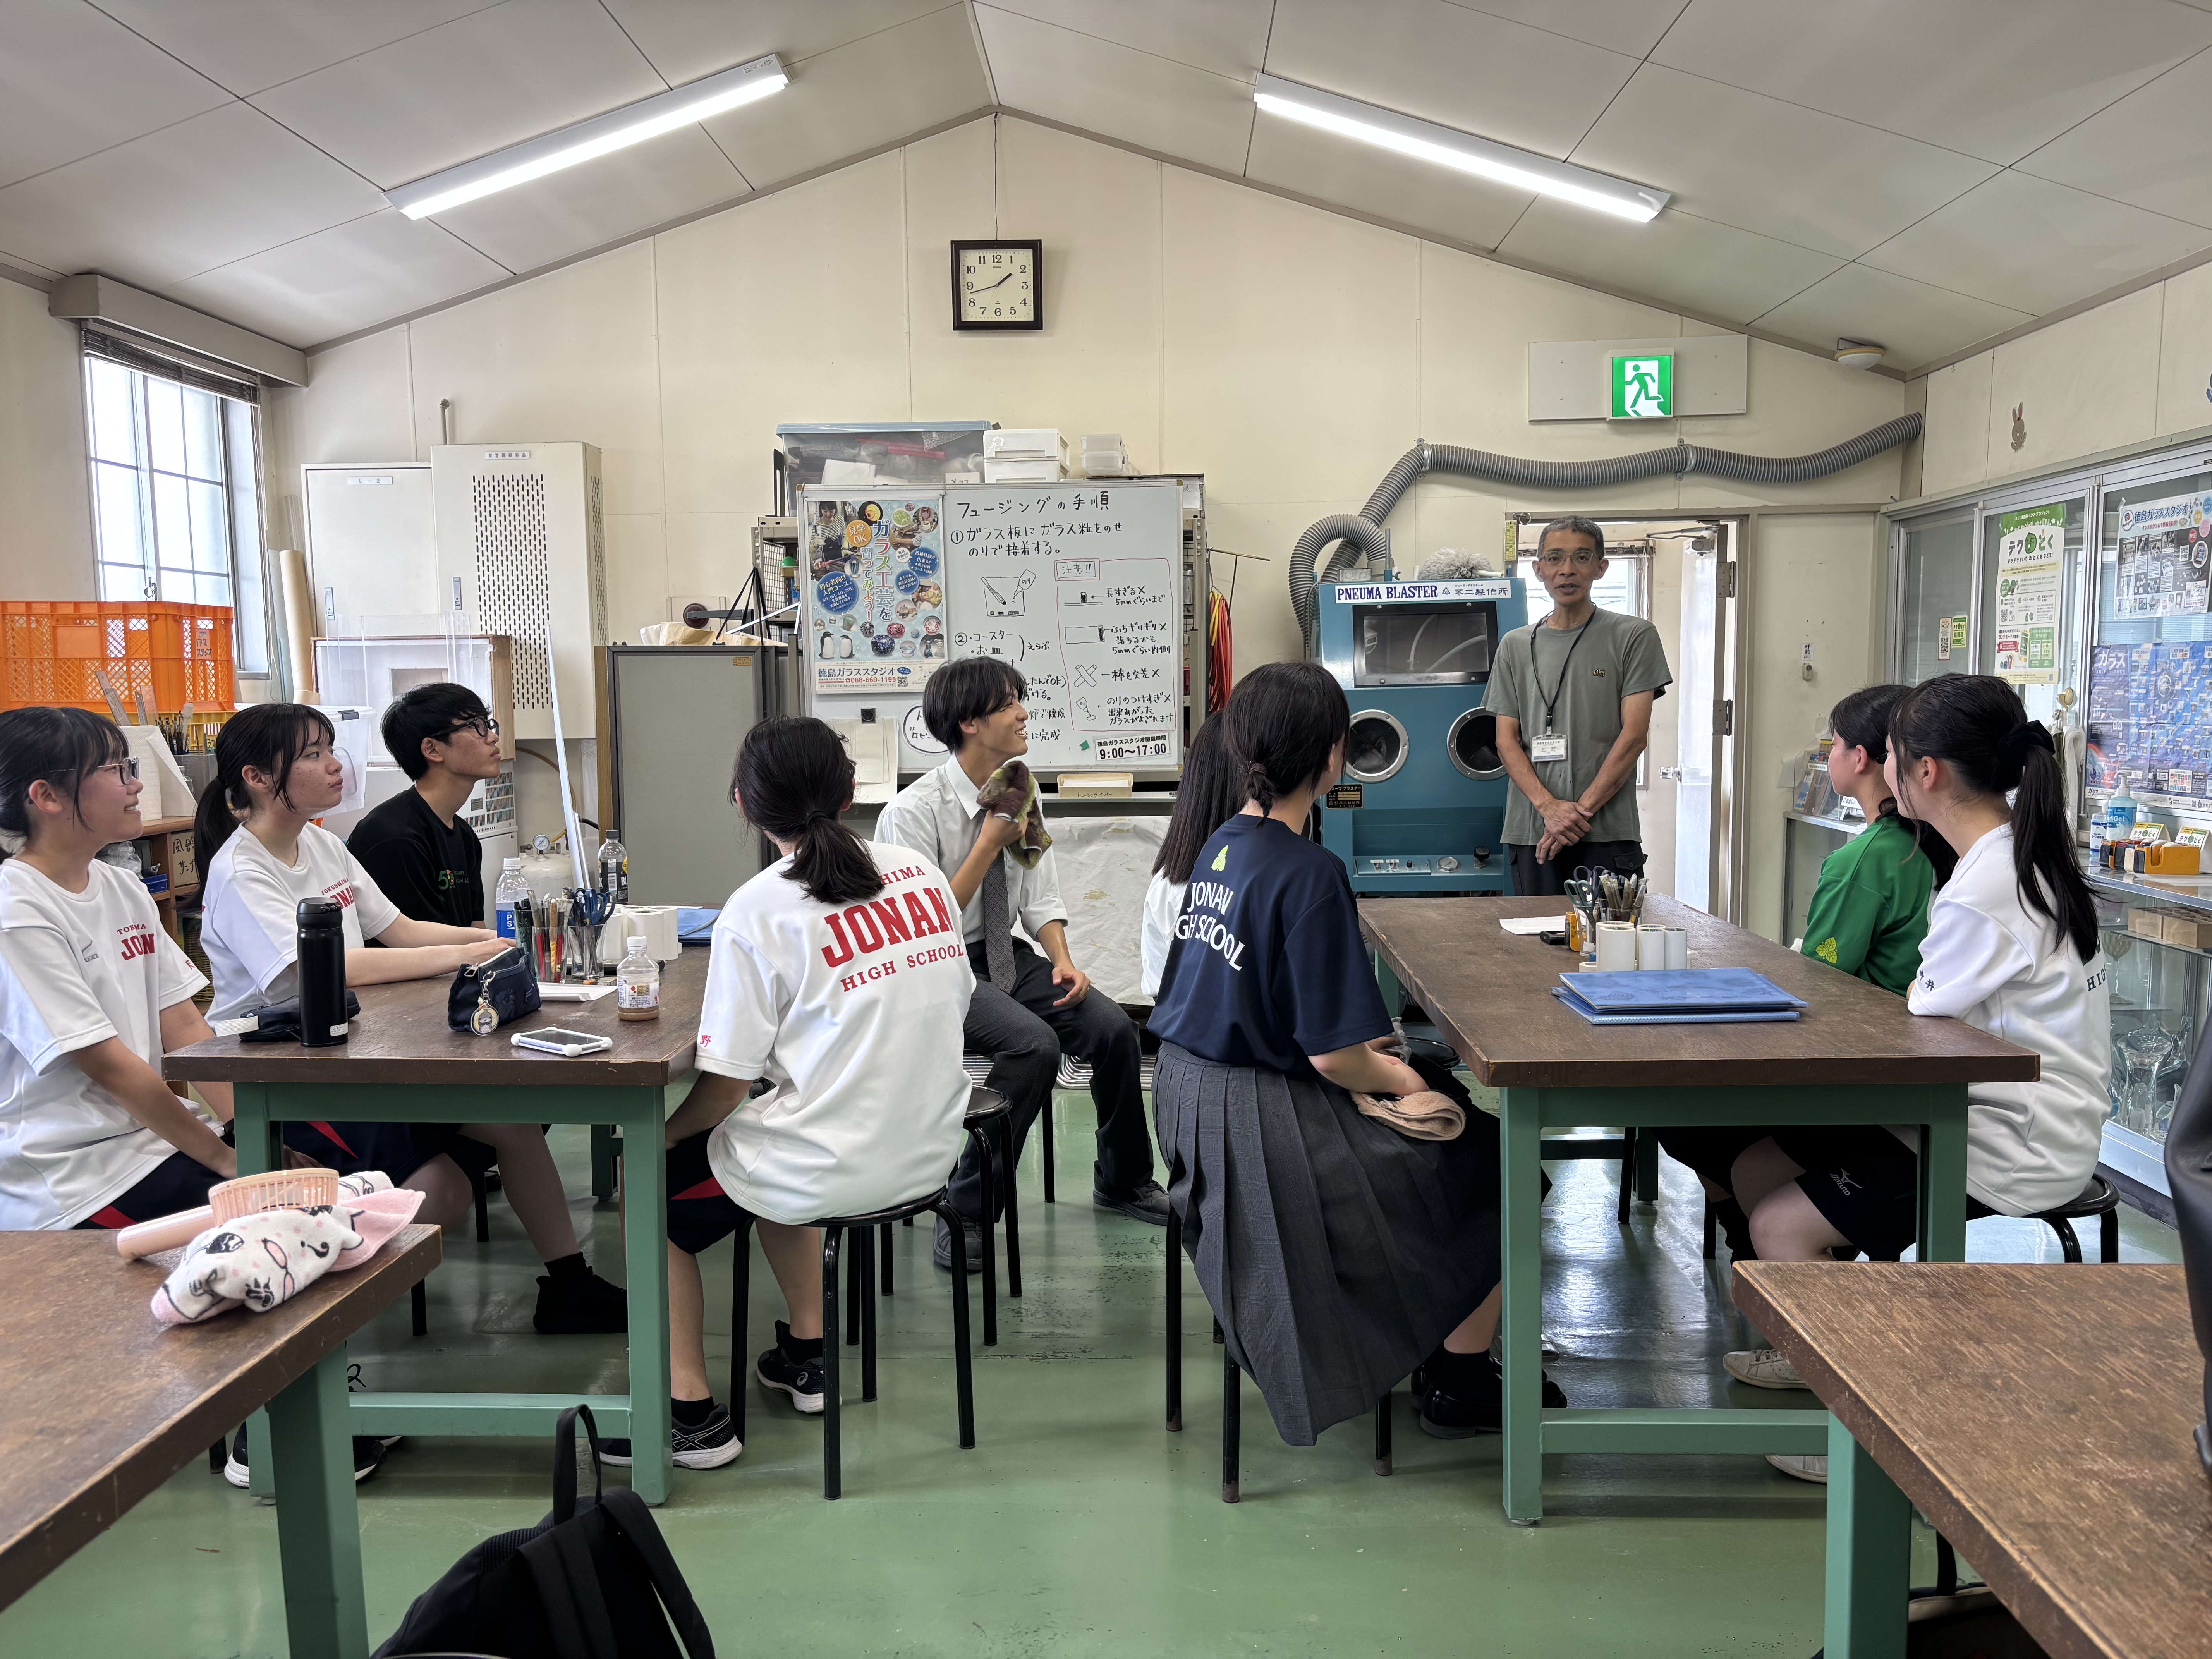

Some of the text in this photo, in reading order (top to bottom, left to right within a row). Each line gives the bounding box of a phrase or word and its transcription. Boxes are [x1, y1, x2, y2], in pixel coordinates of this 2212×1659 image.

[979, 256, 986, 264] 11
[992, 255, 1002, 263] 12
[1020, 265, 1026, 273] 2
[969, 298, 975, 306] 8
[994, 308, 1001, 316] 6
[957, 491, 1109, 518] フュージングの手順
[2135, 503, 2190, 522] 徳島ガラススタジオ
[848, 523, 866, 536] 見学
[854, 534, 867, 544] OK
[969, 541, 1060, 556] のりで接着する。
[873, 520, 894, 622] ガラス工芸を
[823, 581, 849, 596] 入門コース
[1337, 585, 1438, 600] PNEUMA BLASTER
[2099, 649, 2128, 670] ガラス
[818, 667, 896, 678] 徳島ガラススタジオ
[880, 866, 926, 886] HIMA
[1187, 881, 1234, 915] JONAN
[821, 888, 954, 968] JONAN
[1175, 914, 1199, 939] GH
[840, 944, 964, 992] HIGH SCHOOL
[2087, 964, 2106, 991] HIG
[1829, 1173, 1850, 1195] MIZUNO
